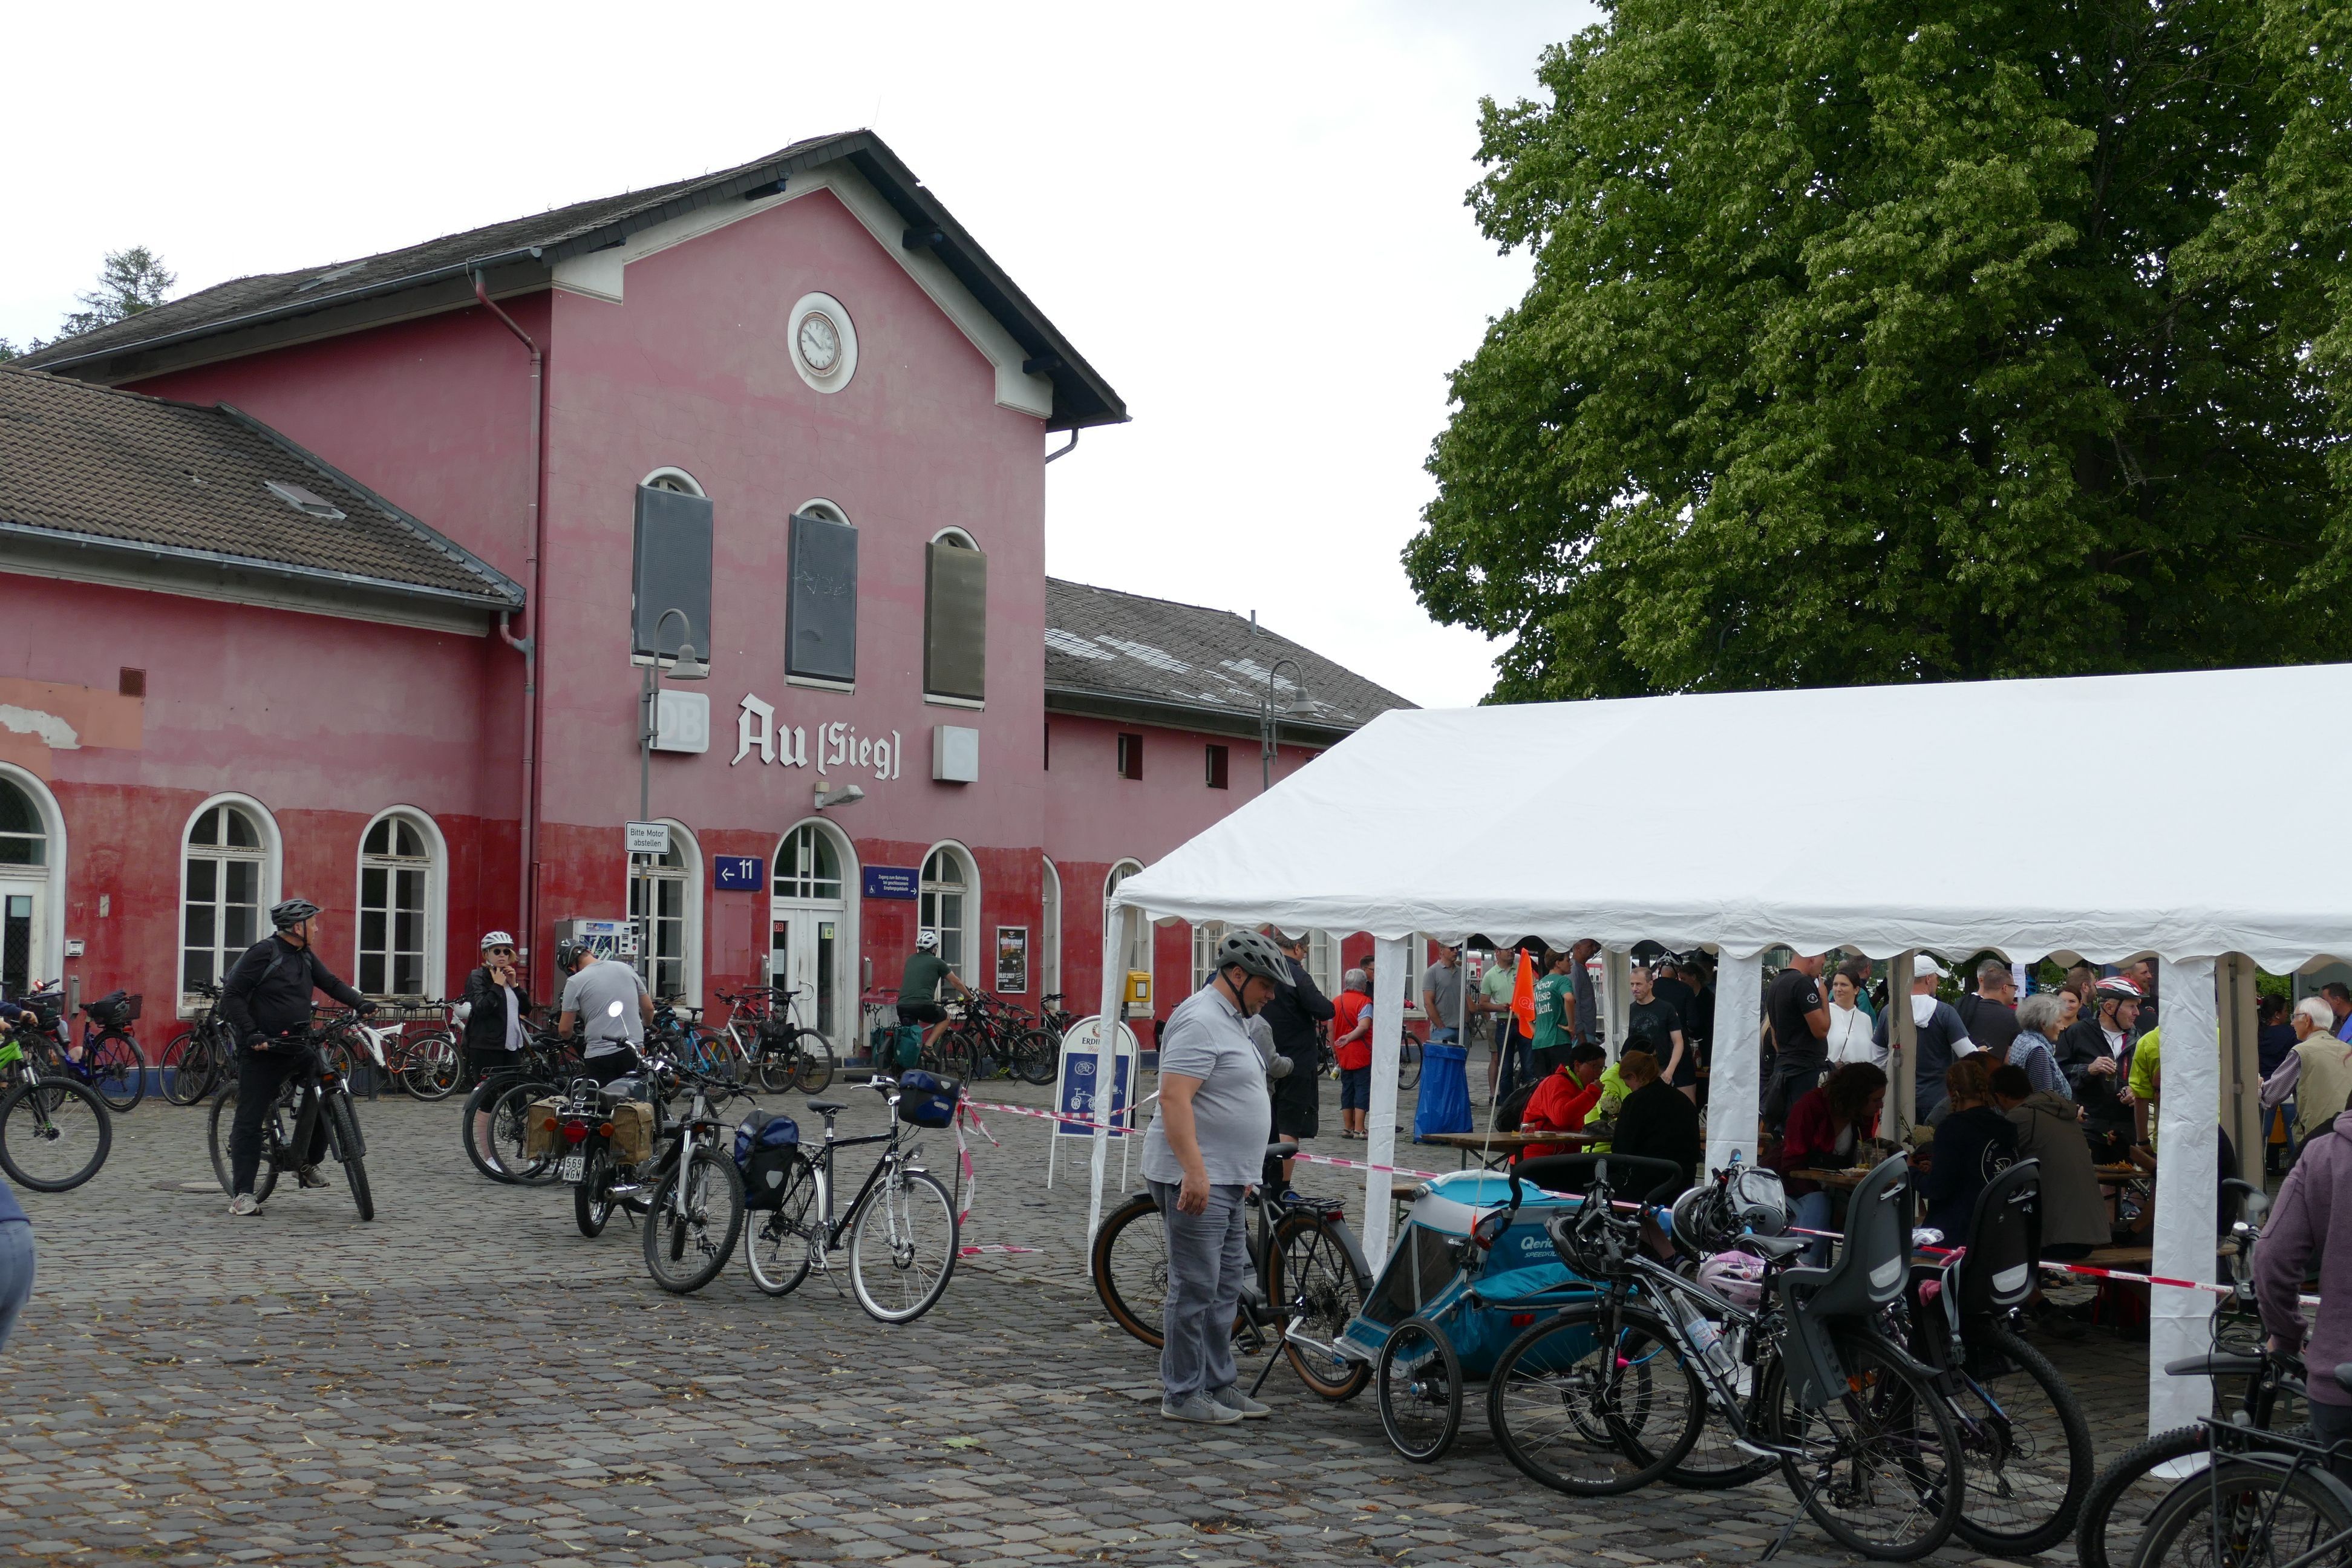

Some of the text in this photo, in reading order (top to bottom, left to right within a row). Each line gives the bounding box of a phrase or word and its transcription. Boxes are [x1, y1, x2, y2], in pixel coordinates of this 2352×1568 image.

[731, 693, 808, 768] Au
[633, 838, 661, 847] abstellen
[739, 859, 752, 879] 11
[566, 1158, 582, 1168] 569
[565, 1169, 581, 1180] WGN
